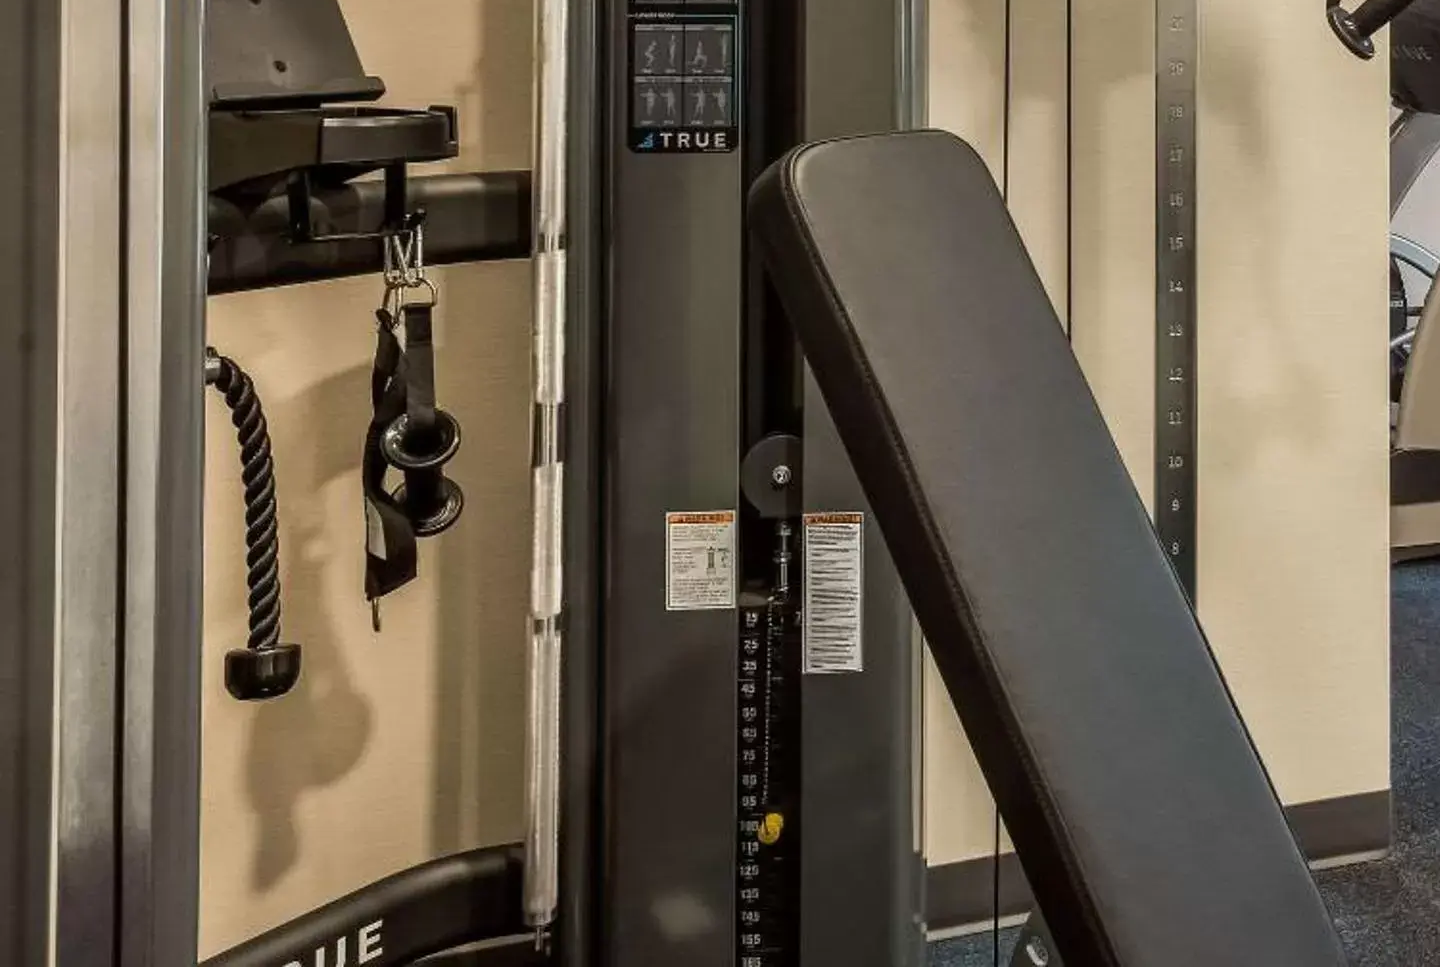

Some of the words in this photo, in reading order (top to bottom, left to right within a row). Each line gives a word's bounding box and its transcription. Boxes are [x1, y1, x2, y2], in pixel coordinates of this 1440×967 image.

[659, 132, 727, 149] TRUE
[1169, 236, 1184, 250] 15
[1168, 367, 1184, 380] 12
[1168, 411, 1183, 424] 11
[1168, 456, 1183, 468] 10
[1171, 499, 1180, 511] 9
[743, 639, 759, 650] 25
[742, 660, 757, 671] 35
[741, 683, 756, 694] 45
[742, 795, 757, 806] 95
[740, 865, 759, 876] 125
[282, 919, 384, 967] UE
[741, 933, 761, 945] 155
